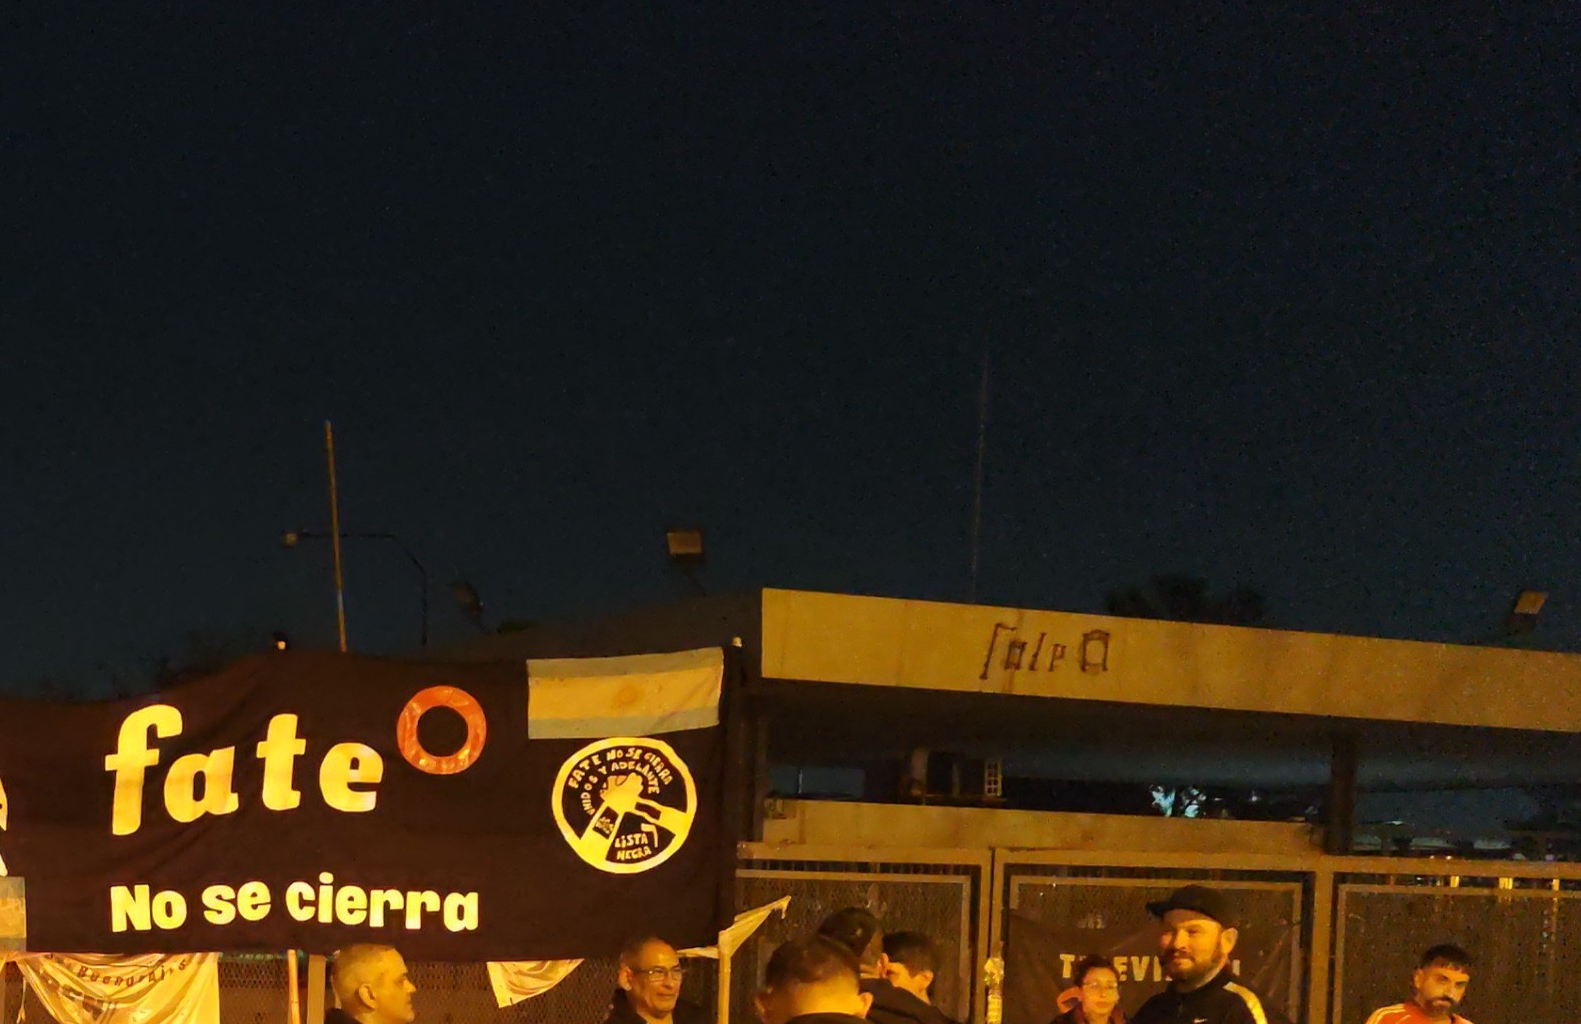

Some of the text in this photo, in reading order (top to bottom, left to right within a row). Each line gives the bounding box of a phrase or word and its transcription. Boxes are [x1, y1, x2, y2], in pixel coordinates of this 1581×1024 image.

[568, 747, 673, 789] FATE NO SE CIERRA
[580, 761, 660, 816] UNIDOS Y ADELANTE
[616, 846, 652, 861] NEGRA
[110, 871, 479, 933] No se cierra
